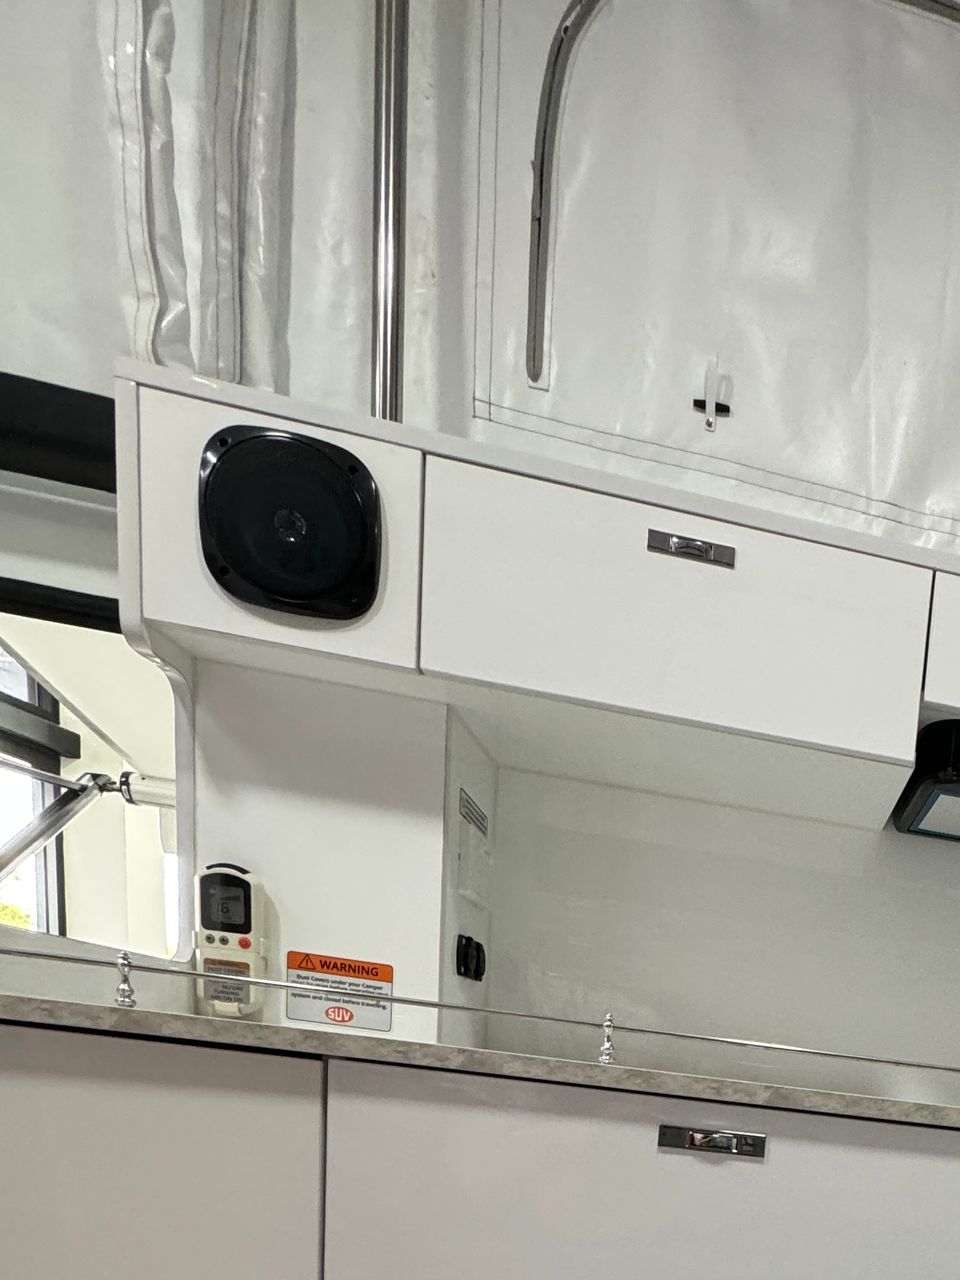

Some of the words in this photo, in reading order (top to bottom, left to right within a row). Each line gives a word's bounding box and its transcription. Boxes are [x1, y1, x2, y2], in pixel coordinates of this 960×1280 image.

[319, 959, 379, 977] WARNING
[361, 982, 384, 991] Camper
[327, 1008, 351, 1021] SUV
